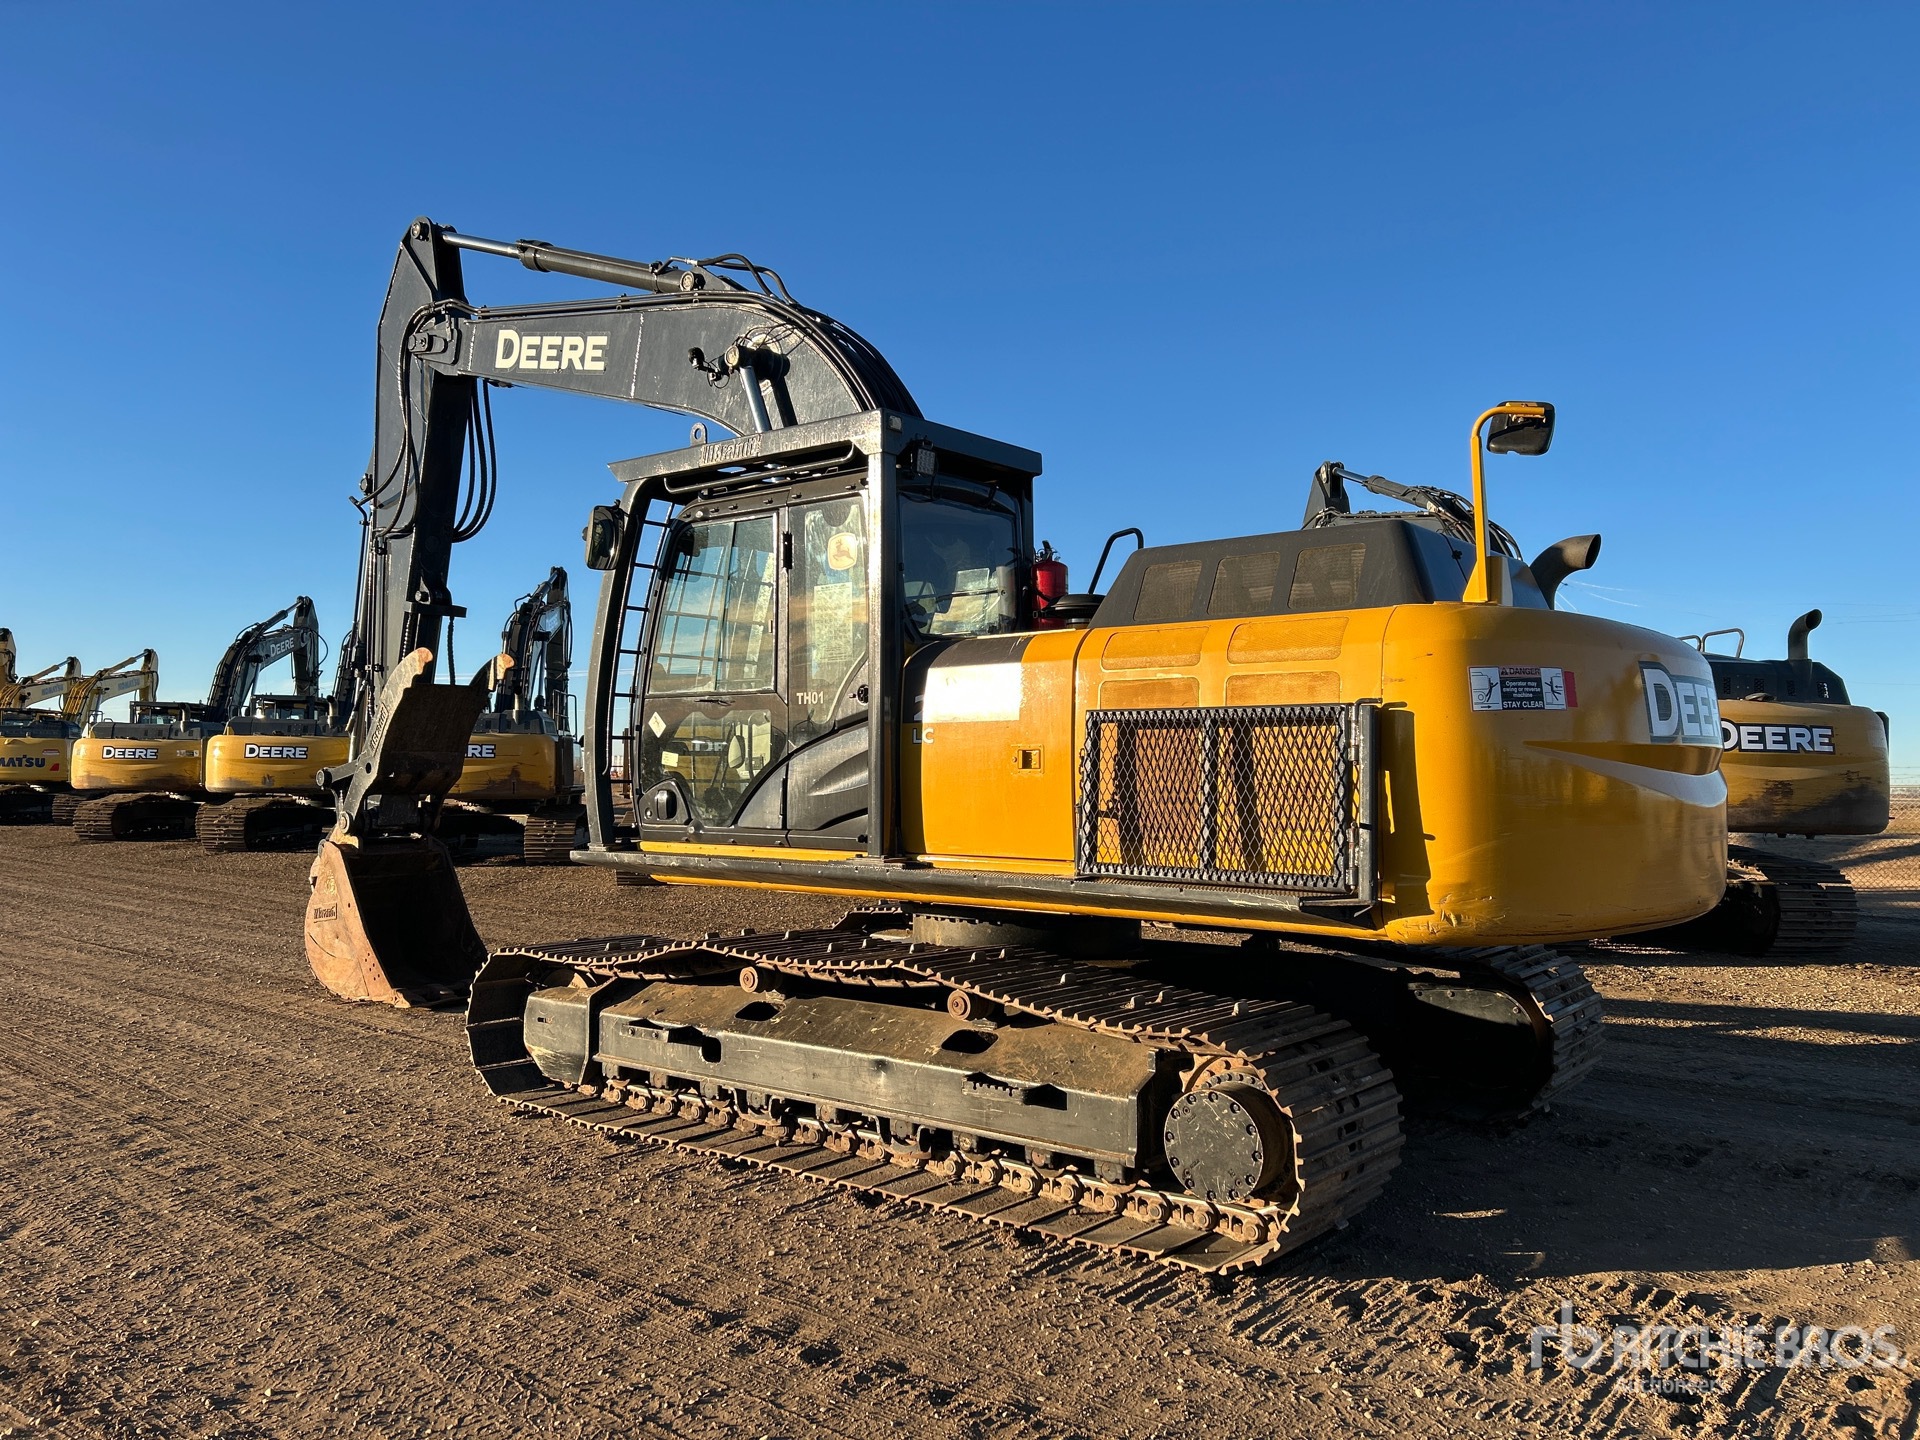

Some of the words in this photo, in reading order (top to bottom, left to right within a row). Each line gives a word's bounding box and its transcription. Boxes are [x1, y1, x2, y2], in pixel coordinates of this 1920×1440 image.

[495, 329, 608, 371] DEERE
[270, 637, 295, 656] DEERE
[1509, 667, 1540, 676] DANGER
[796, 691, 824, 705] TH01
[1503, 701, 1520, 709] STAY
[1522, 701, 1544, 709] CLEAR
[912, 727, 934, 744] LC
[102, 746, 158, 759] DEERE
[245, 744, 308, 759] DEERE
